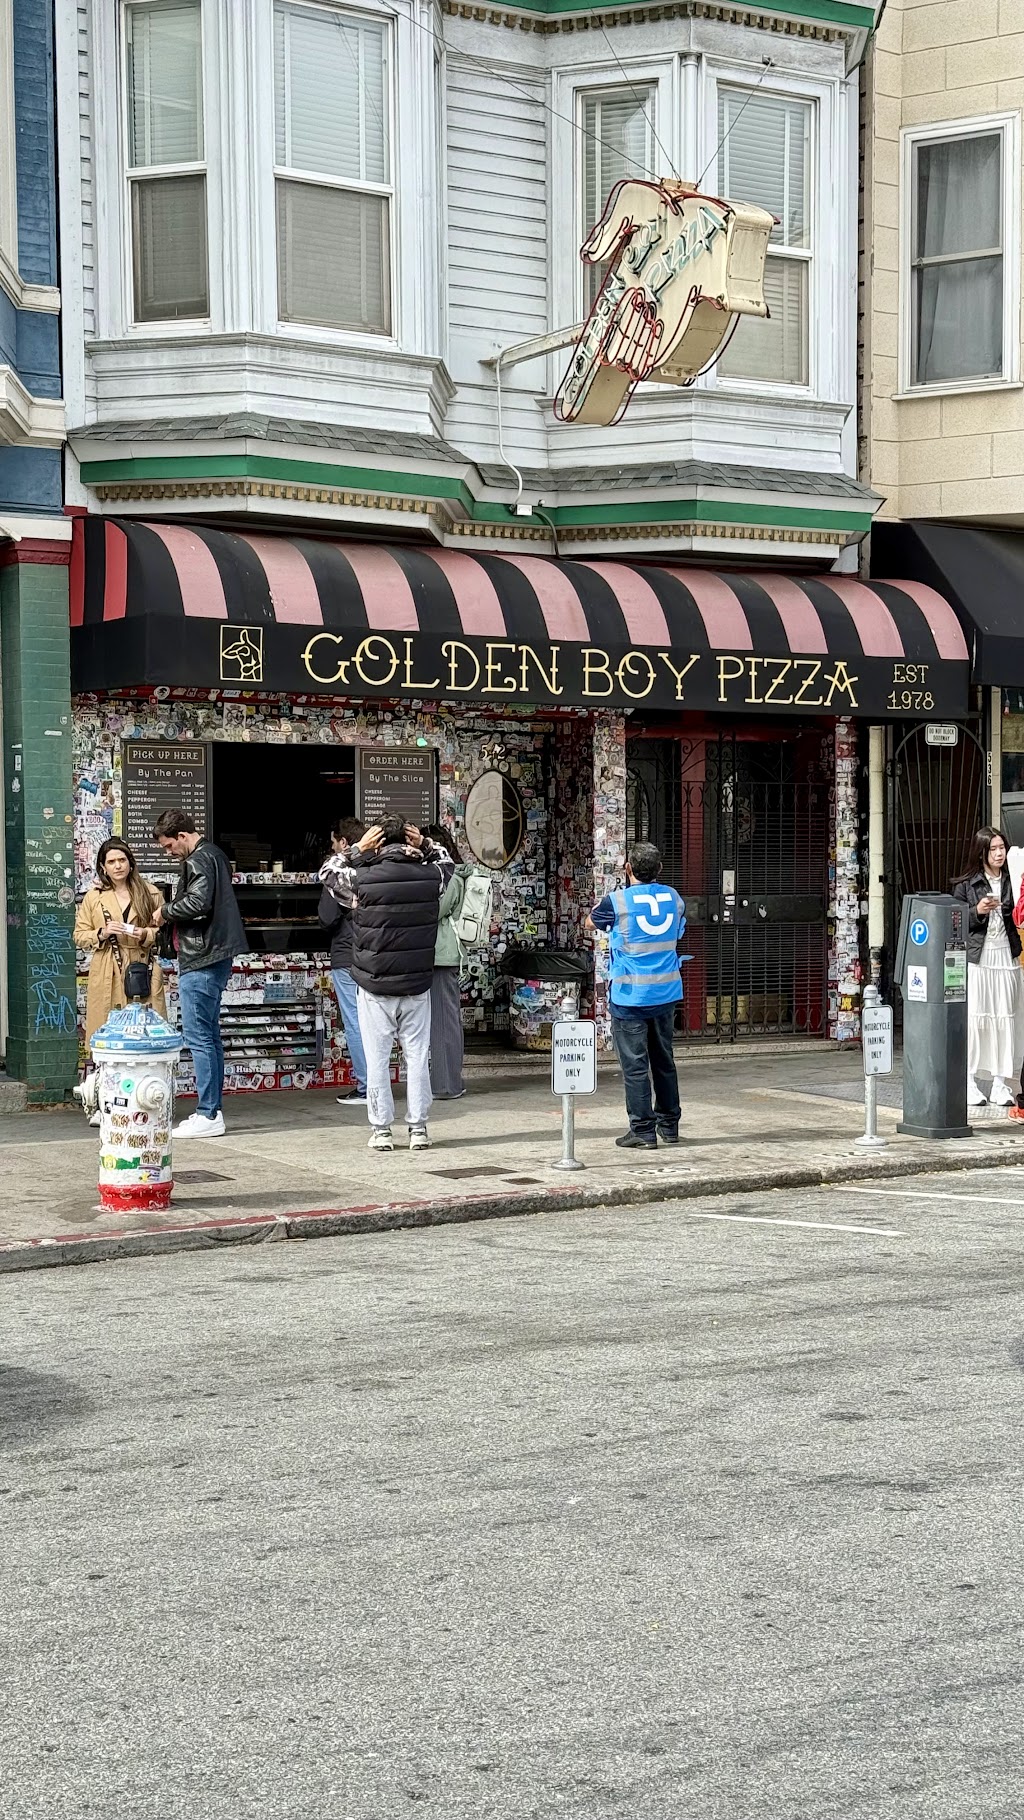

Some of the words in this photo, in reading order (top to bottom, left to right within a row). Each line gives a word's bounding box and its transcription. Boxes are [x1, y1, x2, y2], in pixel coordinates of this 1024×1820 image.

[642, 207, 727, 305] PIZZA
[301, 632, 564, 696] GOLDEN
[581, 648, 700, 700] BOY
[716, 655, 859, 708] PIZZA
[892, 663, 929, 684] EST
[887, 690, 935, 710] 1978
[132, 750, 155, 759] PICK
[158, 751, 171, 760] UP
[173, 751, 199, 760] HERE
[369, 756, 399, 765] ORDER
[401, 757, 424, 766] HERE
[138, 768, 150, 778] By
[153, 769, 172, 777] The
[175, 769, 194, 778] Pan
[369, 774, 380, 783] By
[383, 774, 400, 782] The
[402, 774, 424, 783] Slice
[864, 1022, 890, 1031] MOTORCYCLE
[555, 1038, 593, 1048] MOTORCYCLE
[867, 1036, 885, 1045] PARKING
[560, 1053, 586, 1063] PARKING
[871, 1050, 882, 1059] ONLY
[565, 1068, 581, 1077] ONLY
